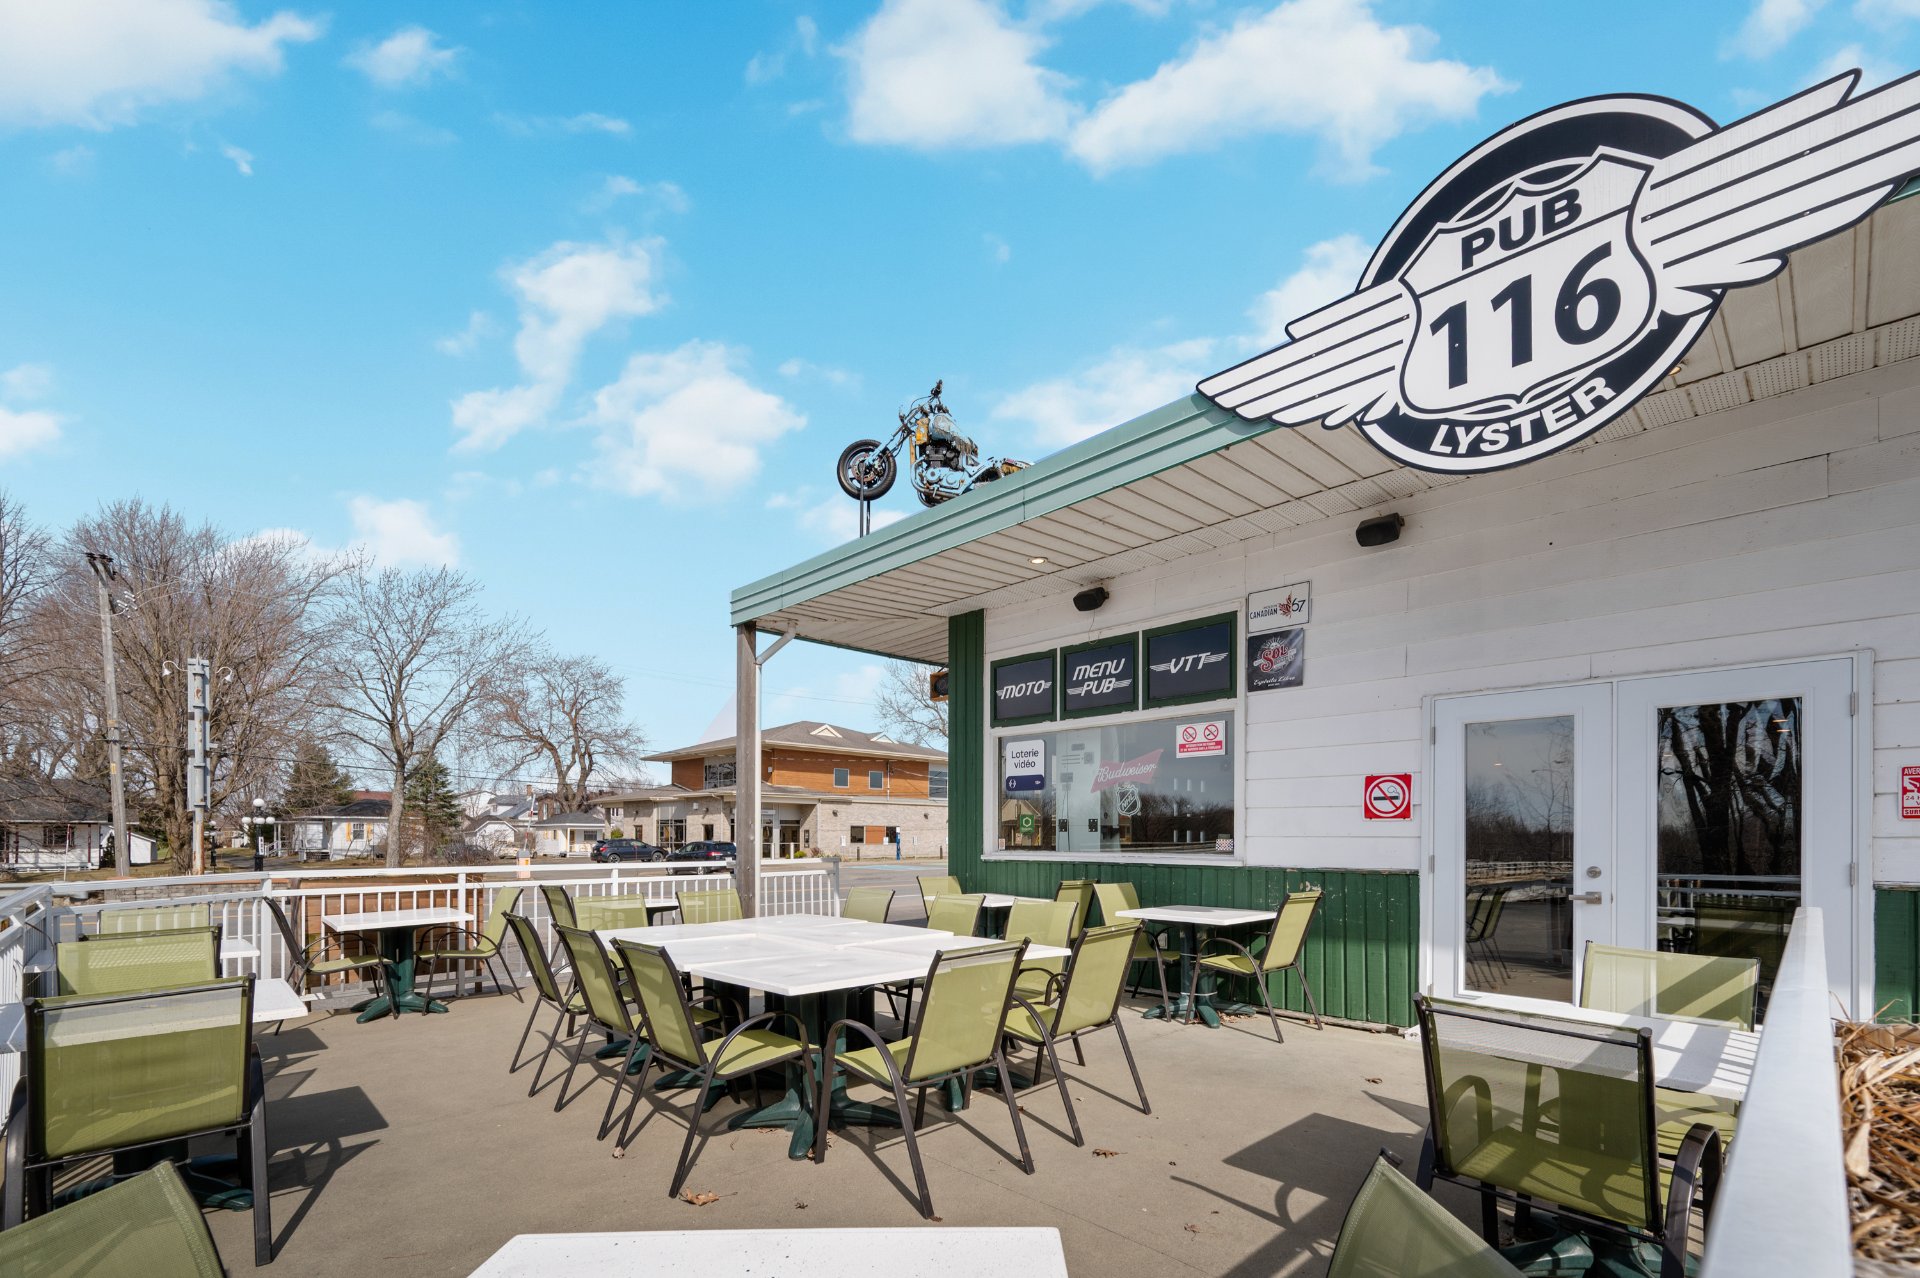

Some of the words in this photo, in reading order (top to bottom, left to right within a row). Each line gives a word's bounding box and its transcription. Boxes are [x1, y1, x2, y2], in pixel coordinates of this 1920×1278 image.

[1461, 188, 1582, 271] PUB
[1429, 240, 1622, 390] 116
[1429, 377, 1617, 455] LYSTER
[1250, 608, 1278, 619] CANADIAN
[1291, 598, 1306, 613] 67
[1072, 658, 1126, 681] MENU
[1169, 651, 1212, 674] VTT
[1000, 680, 1046, 700] MOTO
[1080, 677, 1117, 697] PUB
[1011, 748, 1040, 759] Loterie
[1013, 759, 1036, 769] vidéo
[1097, 761, 1157, 783] Budweiser
[1121, 793, 1136, 811] NHL
